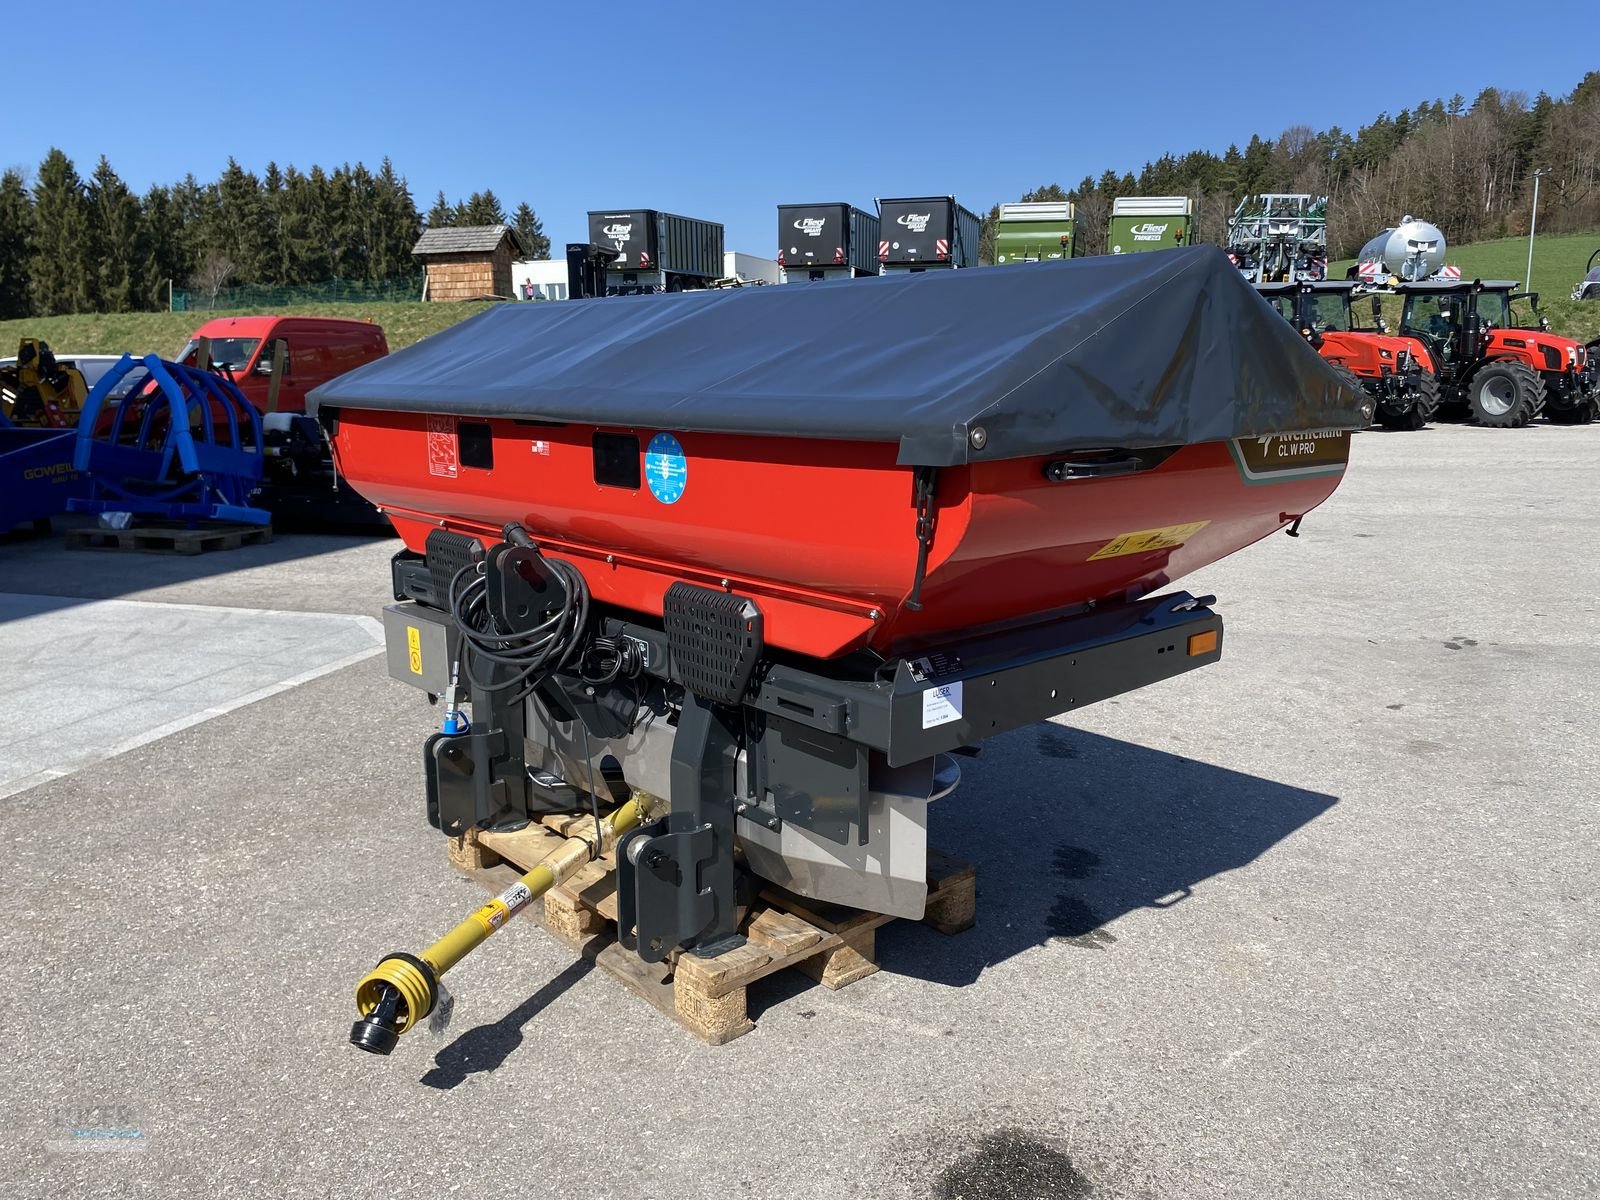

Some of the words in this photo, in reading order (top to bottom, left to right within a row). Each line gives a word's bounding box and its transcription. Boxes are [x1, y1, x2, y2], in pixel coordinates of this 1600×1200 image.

[1278, 444, 1288, 457] CL
[1290, 443, 1298, 456] W
[1299, 441, 1315, 455] PRO
